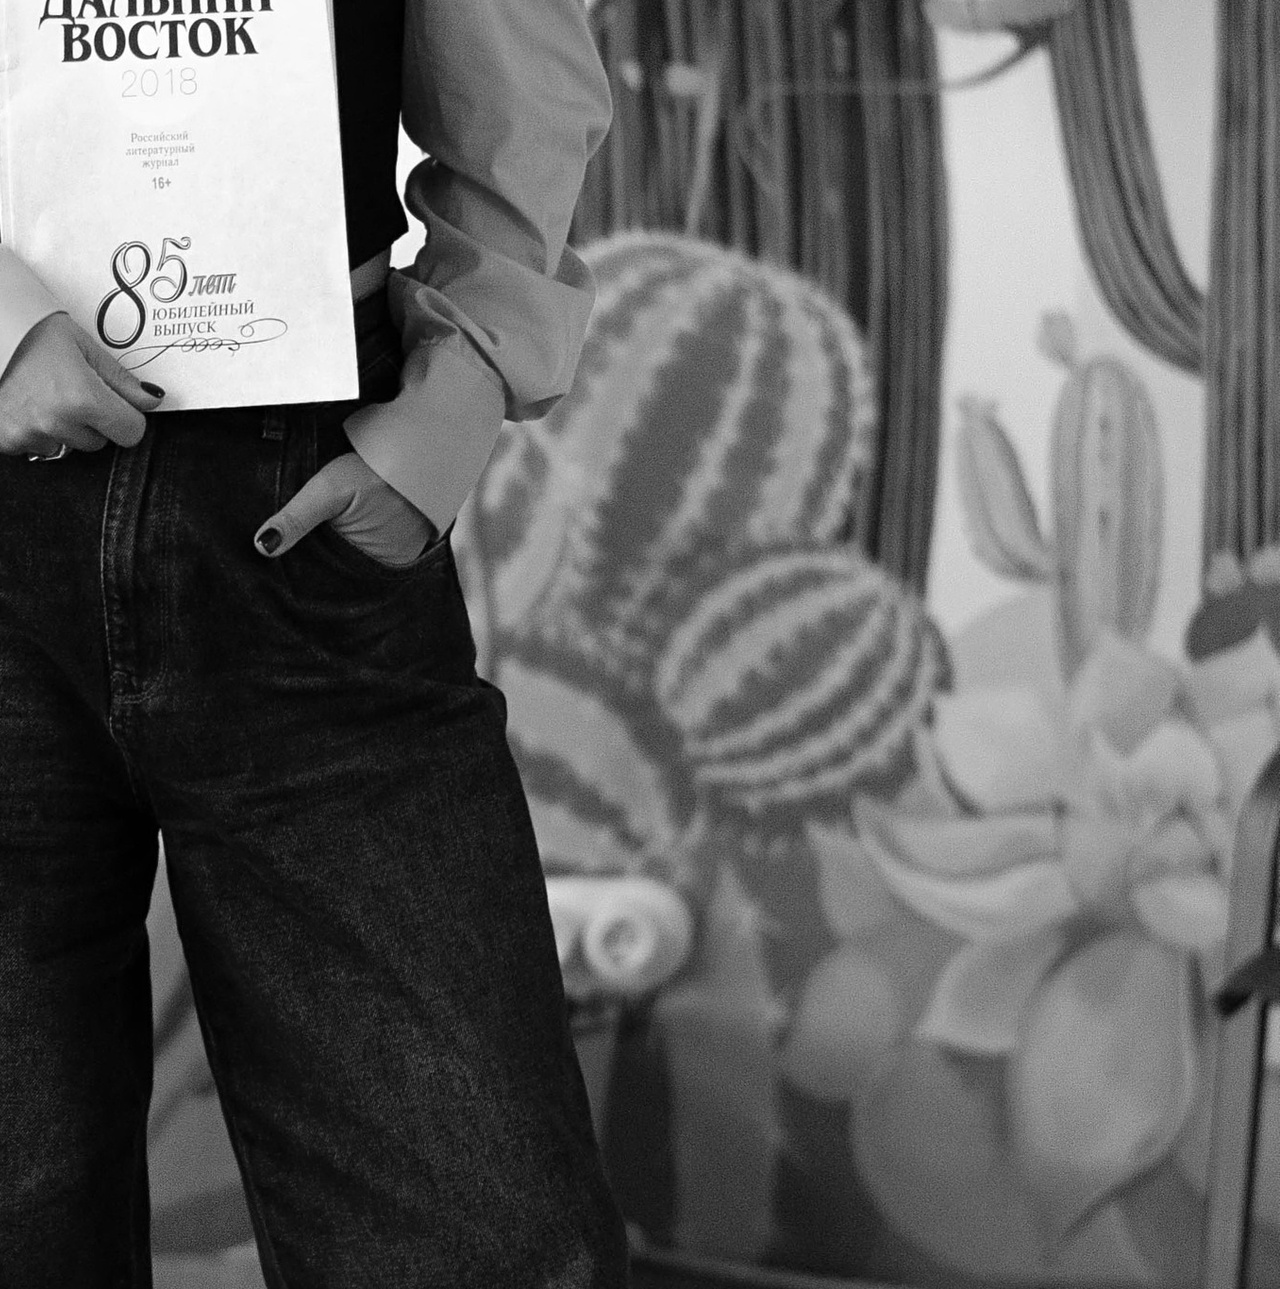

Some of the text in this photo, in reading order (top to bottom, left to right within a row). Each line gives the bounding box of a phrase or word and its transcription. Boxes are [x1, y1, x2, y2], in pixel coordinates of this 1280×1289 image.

[61, 17, 259, 62] ВОСТОК
[121, 67, 198, 98] 2018
[130, 131, 189, 143] Российский
[125, 143, 195, 157] литературный
[142, 158, 180, 169] журнал
[151, 176, 172, 190] 16+
[94, 236, 237, 350] 85 лет
[152, 300, 255, 321] ЮБИЛЕЙНЫЙ
[153, 320, 217, 338] ВЫПУСК
